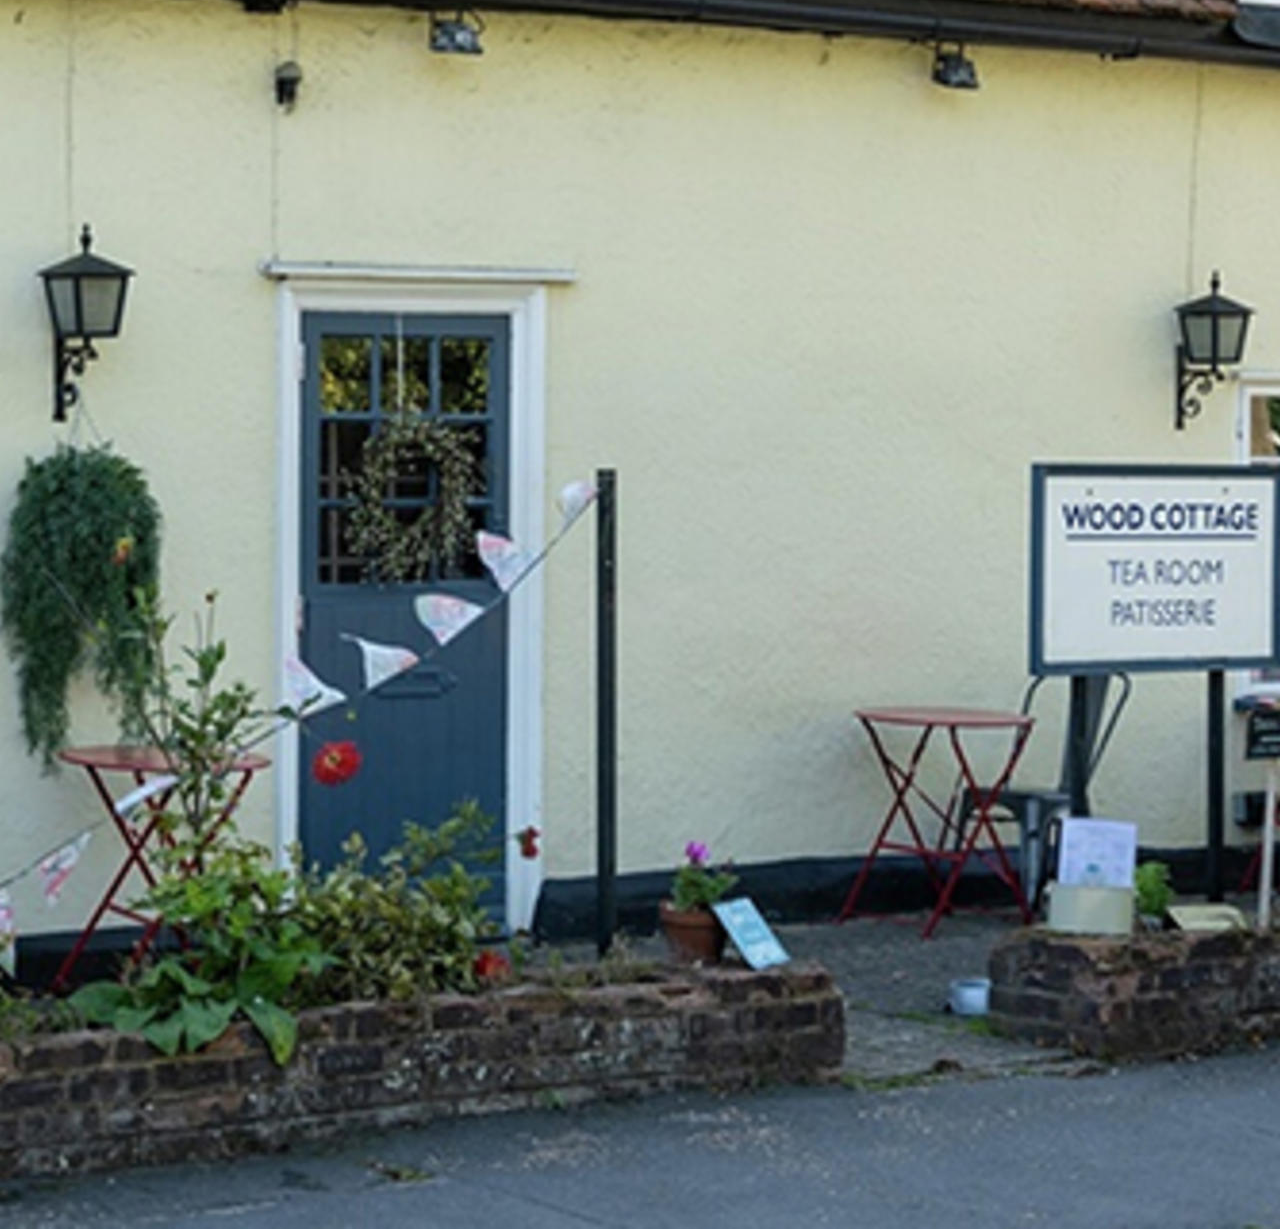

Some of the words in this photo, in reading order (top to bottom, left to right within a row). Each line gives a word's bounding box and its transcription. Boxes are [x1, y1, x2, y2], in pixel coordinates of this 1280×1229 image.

[1062, 503, 1145, 531] WOOD
[1150, 502, 1259, 531] COTTAGE
[1108, 560, 1149, 585] TEA
[1154, 559, 1224, 585] ROOM
[1111, 599, 1216, 626] PATISSERIE
